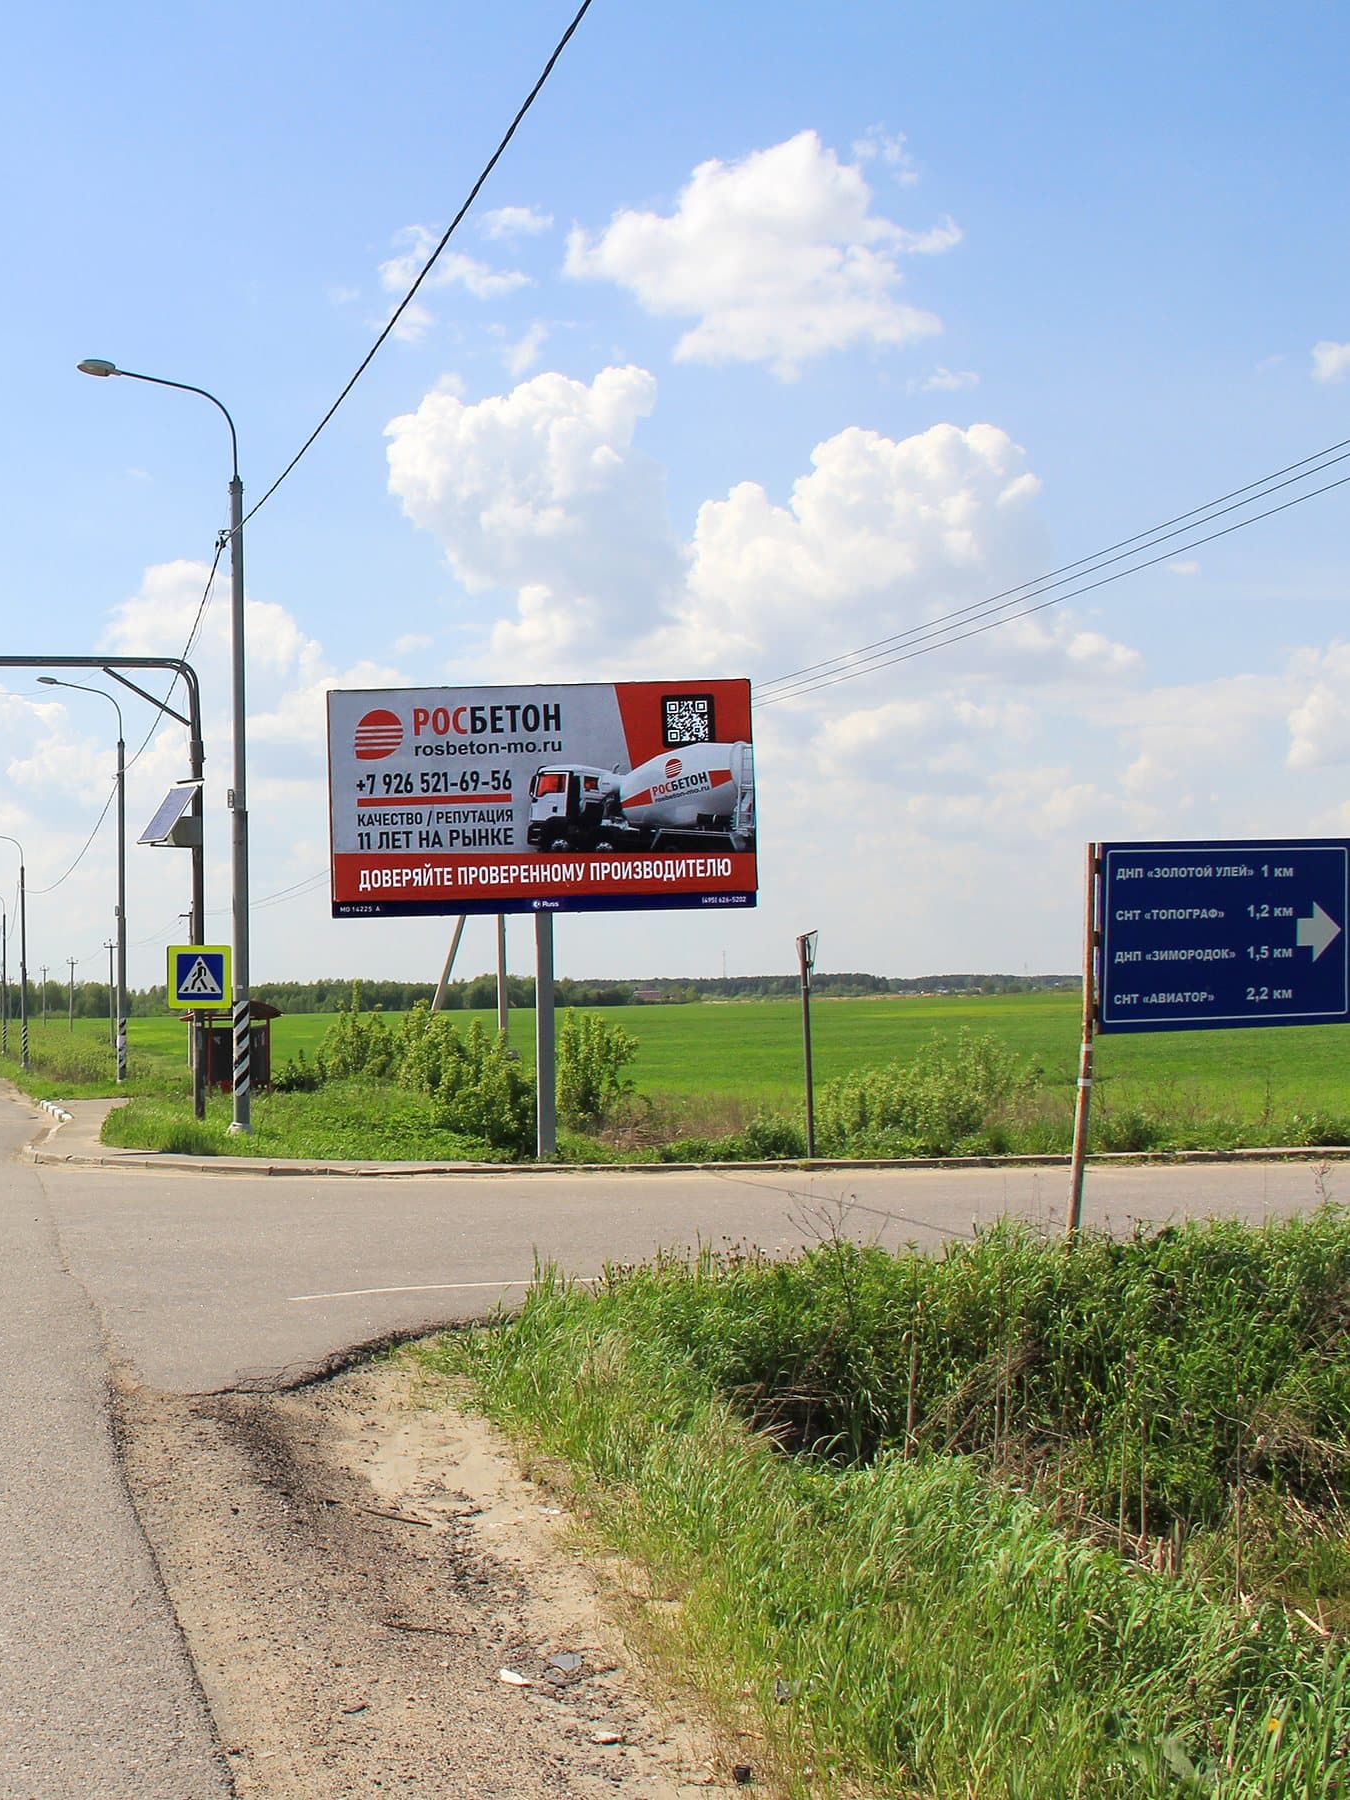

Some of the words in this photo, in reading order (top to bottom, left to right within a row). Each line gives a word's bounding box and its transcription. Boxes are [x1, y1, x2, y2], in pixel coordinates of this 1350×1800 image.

[413, 703, 561, 736] РОСБЕТОН
[414, 740, 562, 756] rosbeton-mo.ru
[356, 774, 376, 794] +7
[383, 773, 414, 794] 926
[420, 770, 512, 793] 521-69-56
[652, 771, 708, 796] РОСБЕТОН
[357, 812, 423, 827] КАЧЕСТВО
[426, 810, 433, 826] /
[436, 809, 513, 825] РЕПУТАЦИЯ
[358, 832, 371, 850] 11
[378, 831, 413, 850] ЛЕТ
[419, 830, 443, 848] НА
[450, 828, 514, 847] РЫНКЕ
[359, 863, 453, 892] ДОВЕРЯЙТЕ
[458, 863, 585, 886] ПРОВЕРЕННОМУ
[590, 858, 732, 882] ПРОИЗВОДИТЕЛЮ
[1116, 867, 1143, 880] ДНП
[1147, 865, 1213, 879] «ЗОЛОТОЙ
[1215, 864, 1254, 878] УЛЕЙ»
[1261, 865, 1269, 878] 1
[1115, 909, 1141, 921] СНТ
[1144, 908, 1225, 920] «ТОПОГРАФ»
[1247, 904, 1270, 920] 1,2
[1114, 951, 1142, 964] ДНП
[1145, 948, 1236, 962] «ЗИМОРОДОК»
[1247, 945, 1269, 961] 1,5
[1114, 994, 1139, 1005] СНТ
[1142, 991, 1215, 1004] «АВИАТОР»
[1246, 987, 1269, 1002] 2,2
